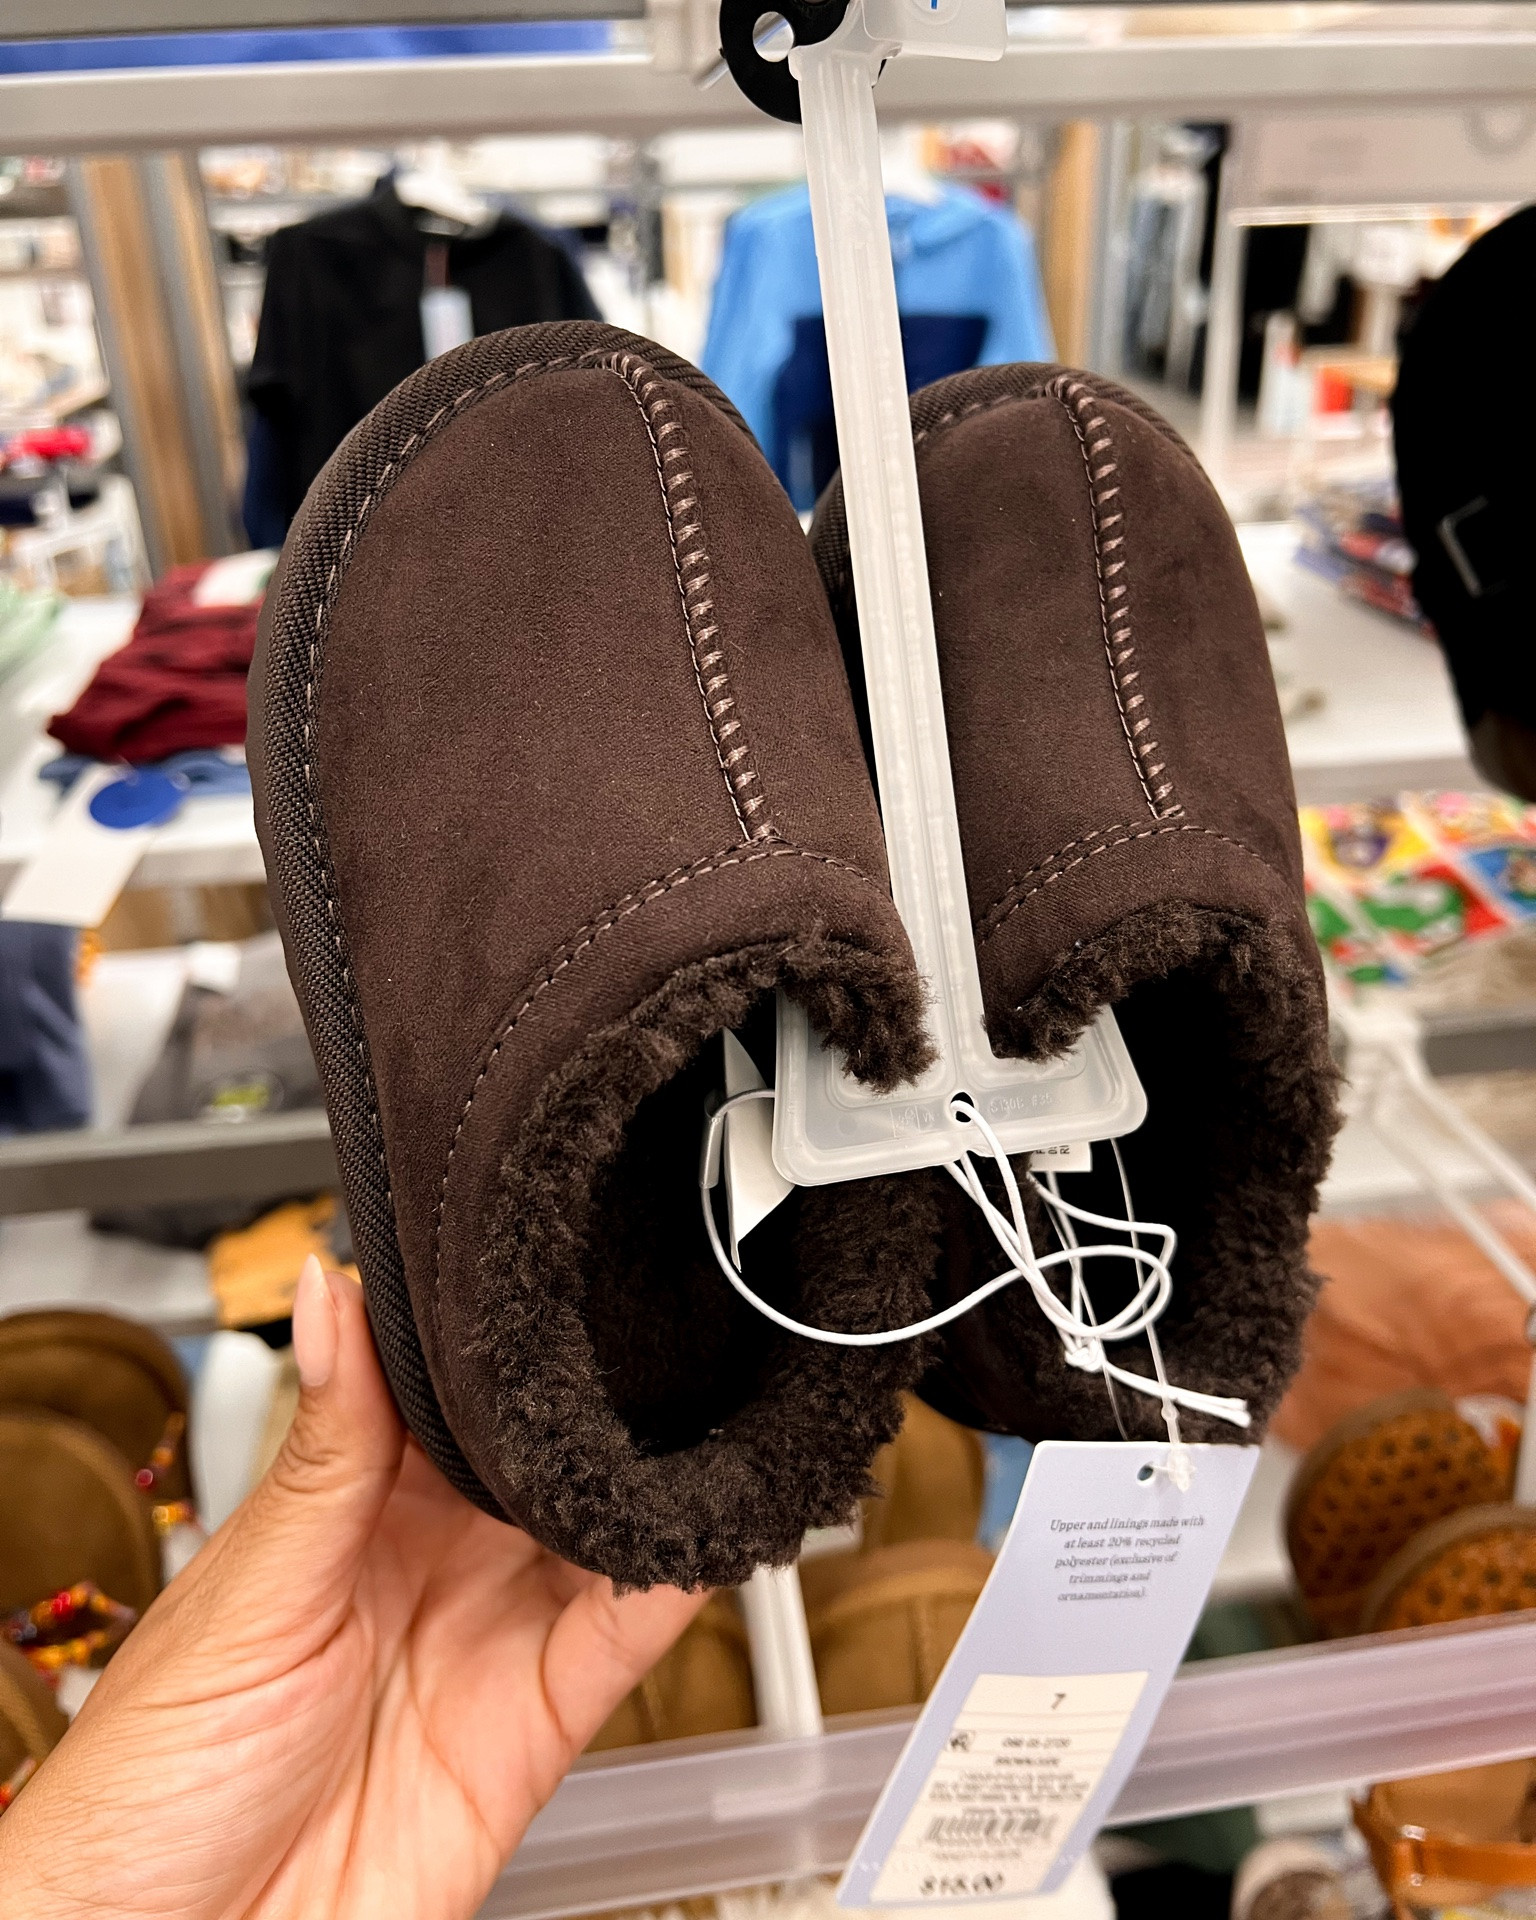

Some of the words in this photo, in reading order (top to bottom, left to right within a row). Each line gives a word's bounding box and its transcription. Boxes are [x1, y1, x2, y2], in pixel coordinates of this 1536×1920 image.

[1050, 1518, 1086, 1532] Upper
[1086, 1518, 1108, 1530] and
[1109, 1517, 1149, 1531] linings
[1150, 1515, 1178, 1528] made
[1180, 1515, 1205, 1527] with
[1064, 1537, 1076, 1549] at
[1077, 1536, 1105, 1548] least
[1107, 1536, 1132, 1547] 20%
[1135, 1534, 1181, 1548] recycled
[1055, 1555, 1106, 1569] polyester
[1110, 1552, 1163, 1567] (exclusive
[1164, 1551, 1178, 1562] of
[1069, 1572, 1128, 1584] trimmings
[1130, 1569, 1151, 1581] and
[1051, 1692, 1067, 1710] 7
